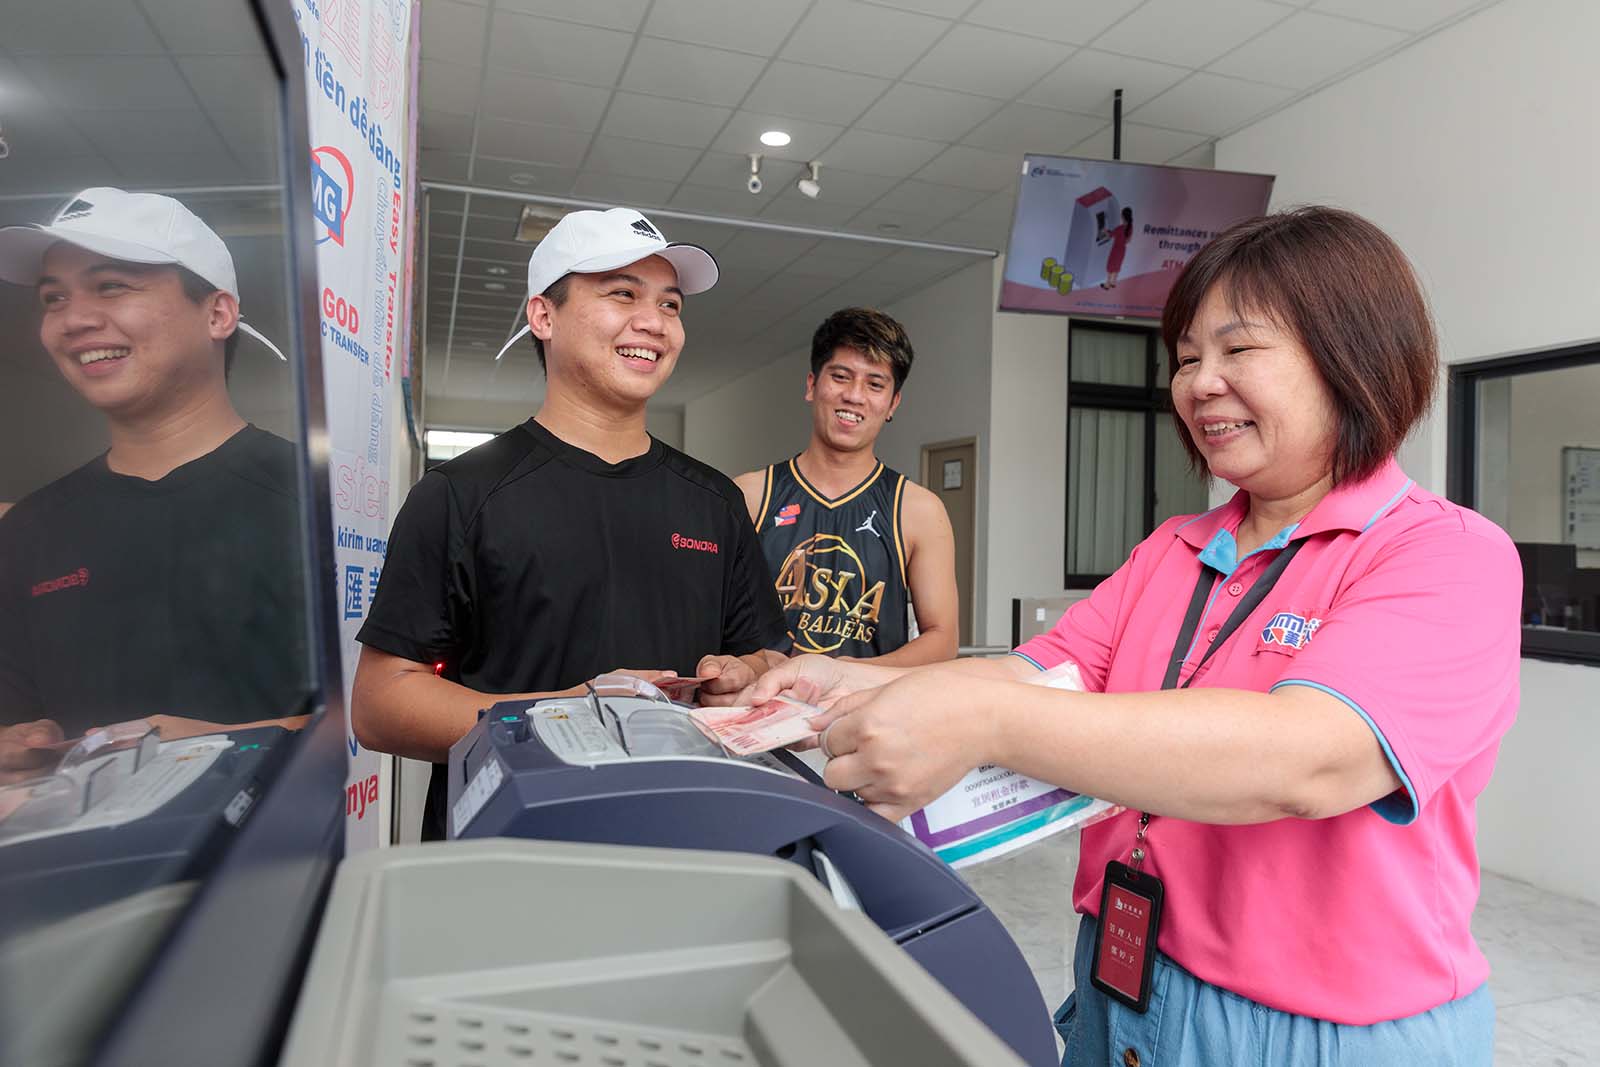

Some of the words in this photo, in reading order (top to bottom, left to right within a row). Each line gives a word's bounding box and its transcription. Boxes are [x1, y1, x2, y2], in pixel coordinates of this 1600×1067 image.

[389, 191, 401, 255] Easy
[633, 230, 662, 241] adidas
[1143, 223, 1208, 239] Remittances
[1159, 240, 1201, 254] through
[323, 287, 359, 335] GOD
[329, 325, 370, 366] TRANSFER
[338, 526, 363, 550] kirim
[679, 536, 719, 554] SONORA
[774, 549, 886, 624] ASIA
[798, 611, 876, 644] BALLERS
